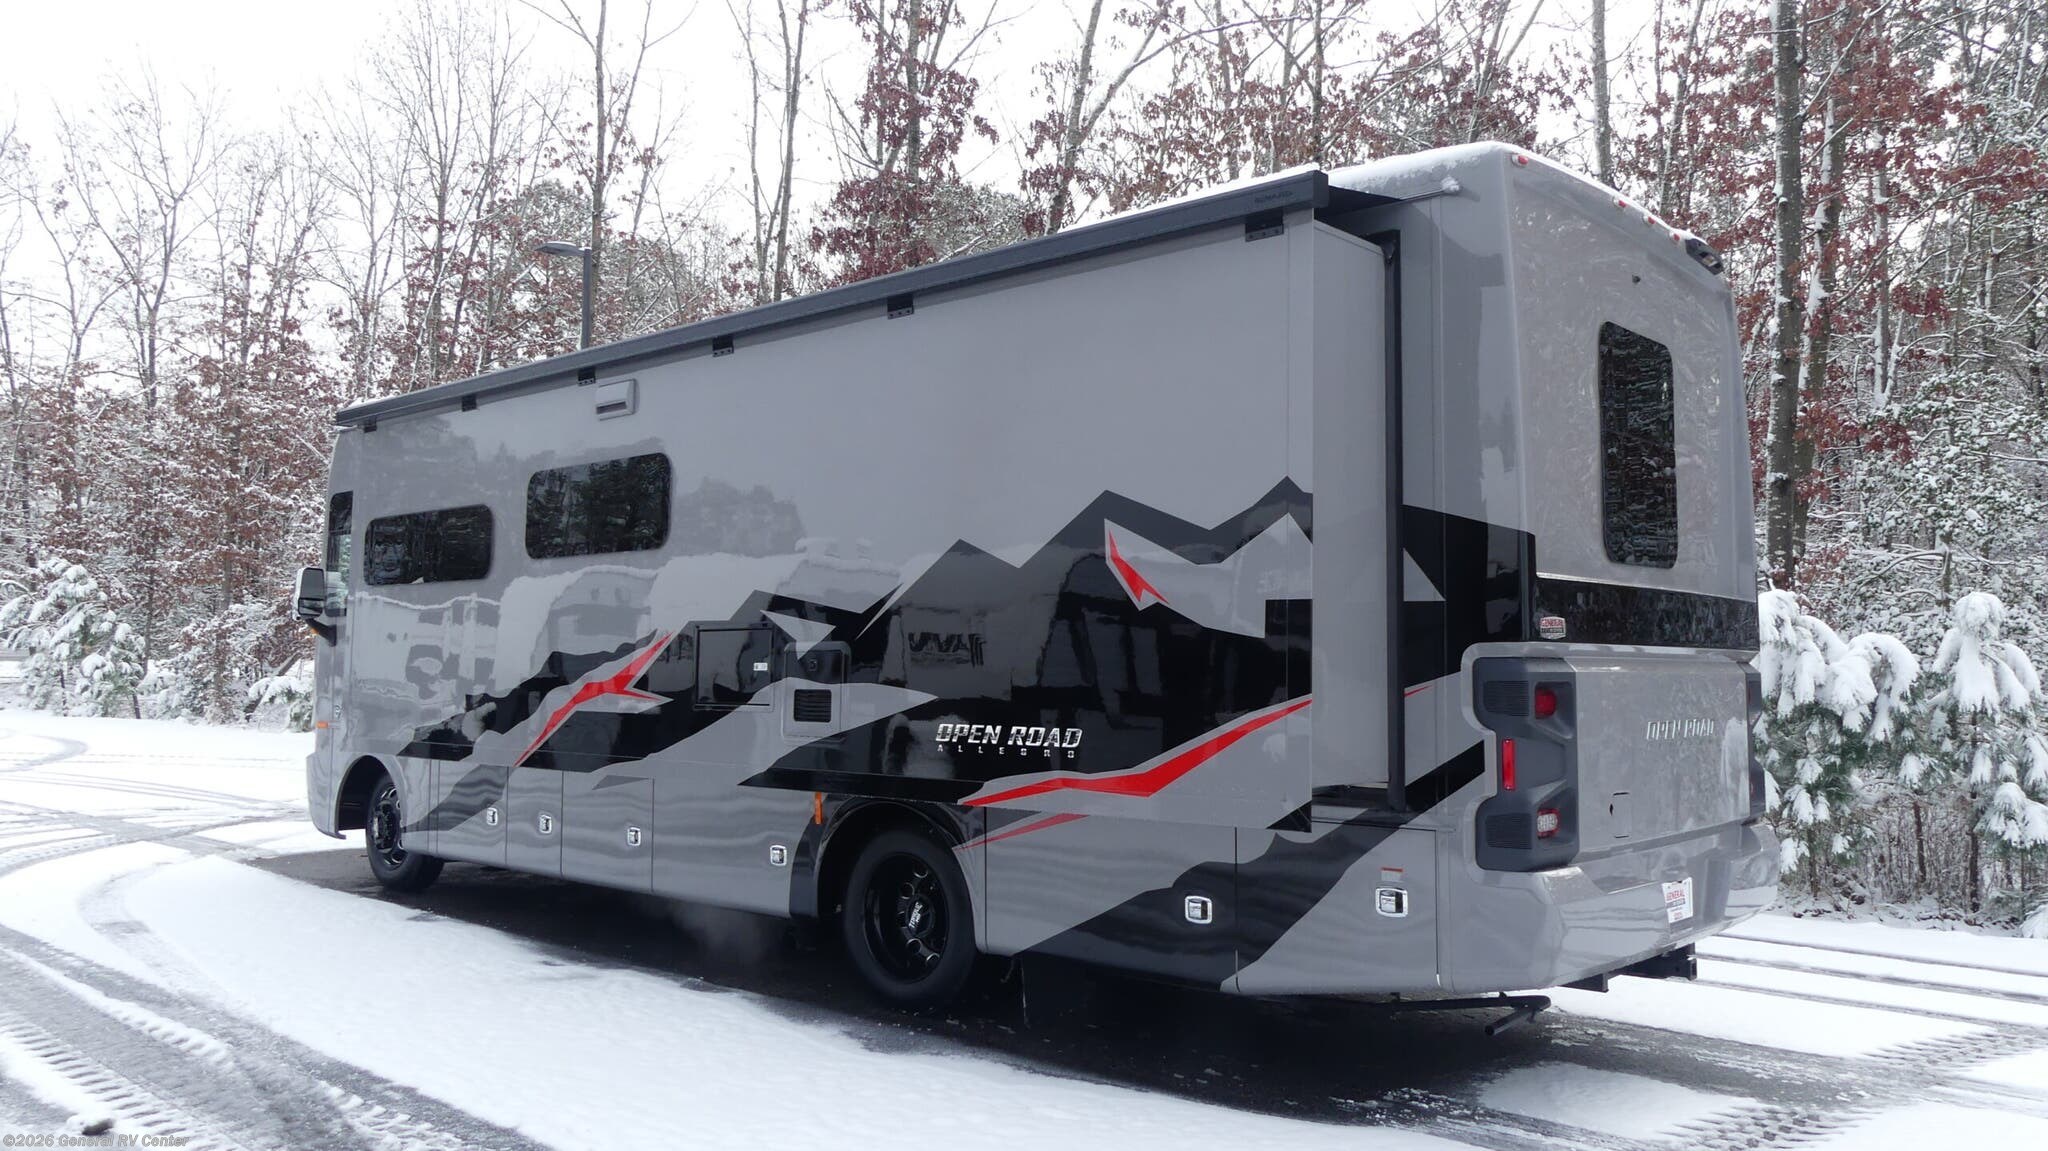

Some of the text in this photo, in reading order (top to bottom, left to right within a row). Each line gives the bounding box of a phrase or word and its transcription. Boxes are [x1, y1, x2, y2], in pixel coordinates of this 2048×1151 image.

[935, 723, 1083, 748] OPEN ROAD
[1646, 718, 1714, 740] OPEN ROAD
[937, 744, 1075, 758] ALLEGRO
